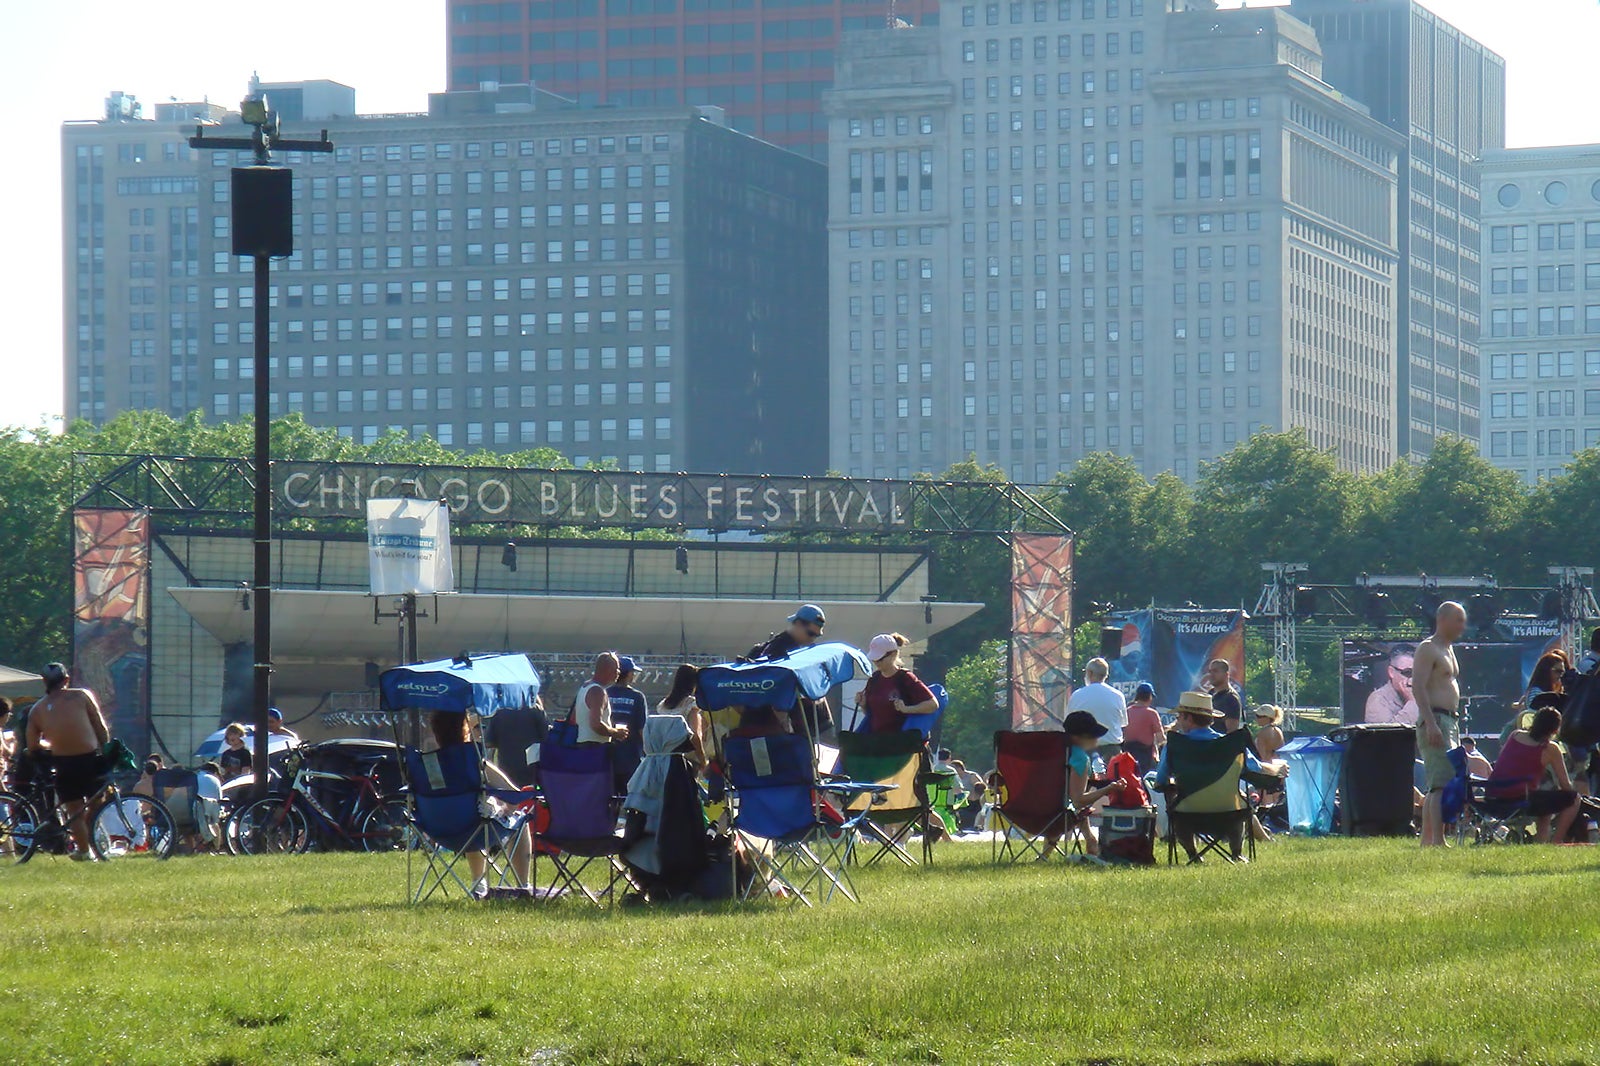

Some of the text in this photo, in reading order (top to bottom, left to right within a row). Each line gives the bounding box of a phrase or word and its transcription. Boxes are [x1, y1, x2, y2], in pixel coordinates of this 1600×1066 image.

[541, 481, 678, 518] BLUES
[707, 487, 905, 524] FESTIVAL
[402, 536, 433, 547] Tribune
[1156, 613, 1181, 624] Chicago
[1178, 624, 1229, 633] It's All Here.
[1513, 626, 1561, 636] It's All Here.
